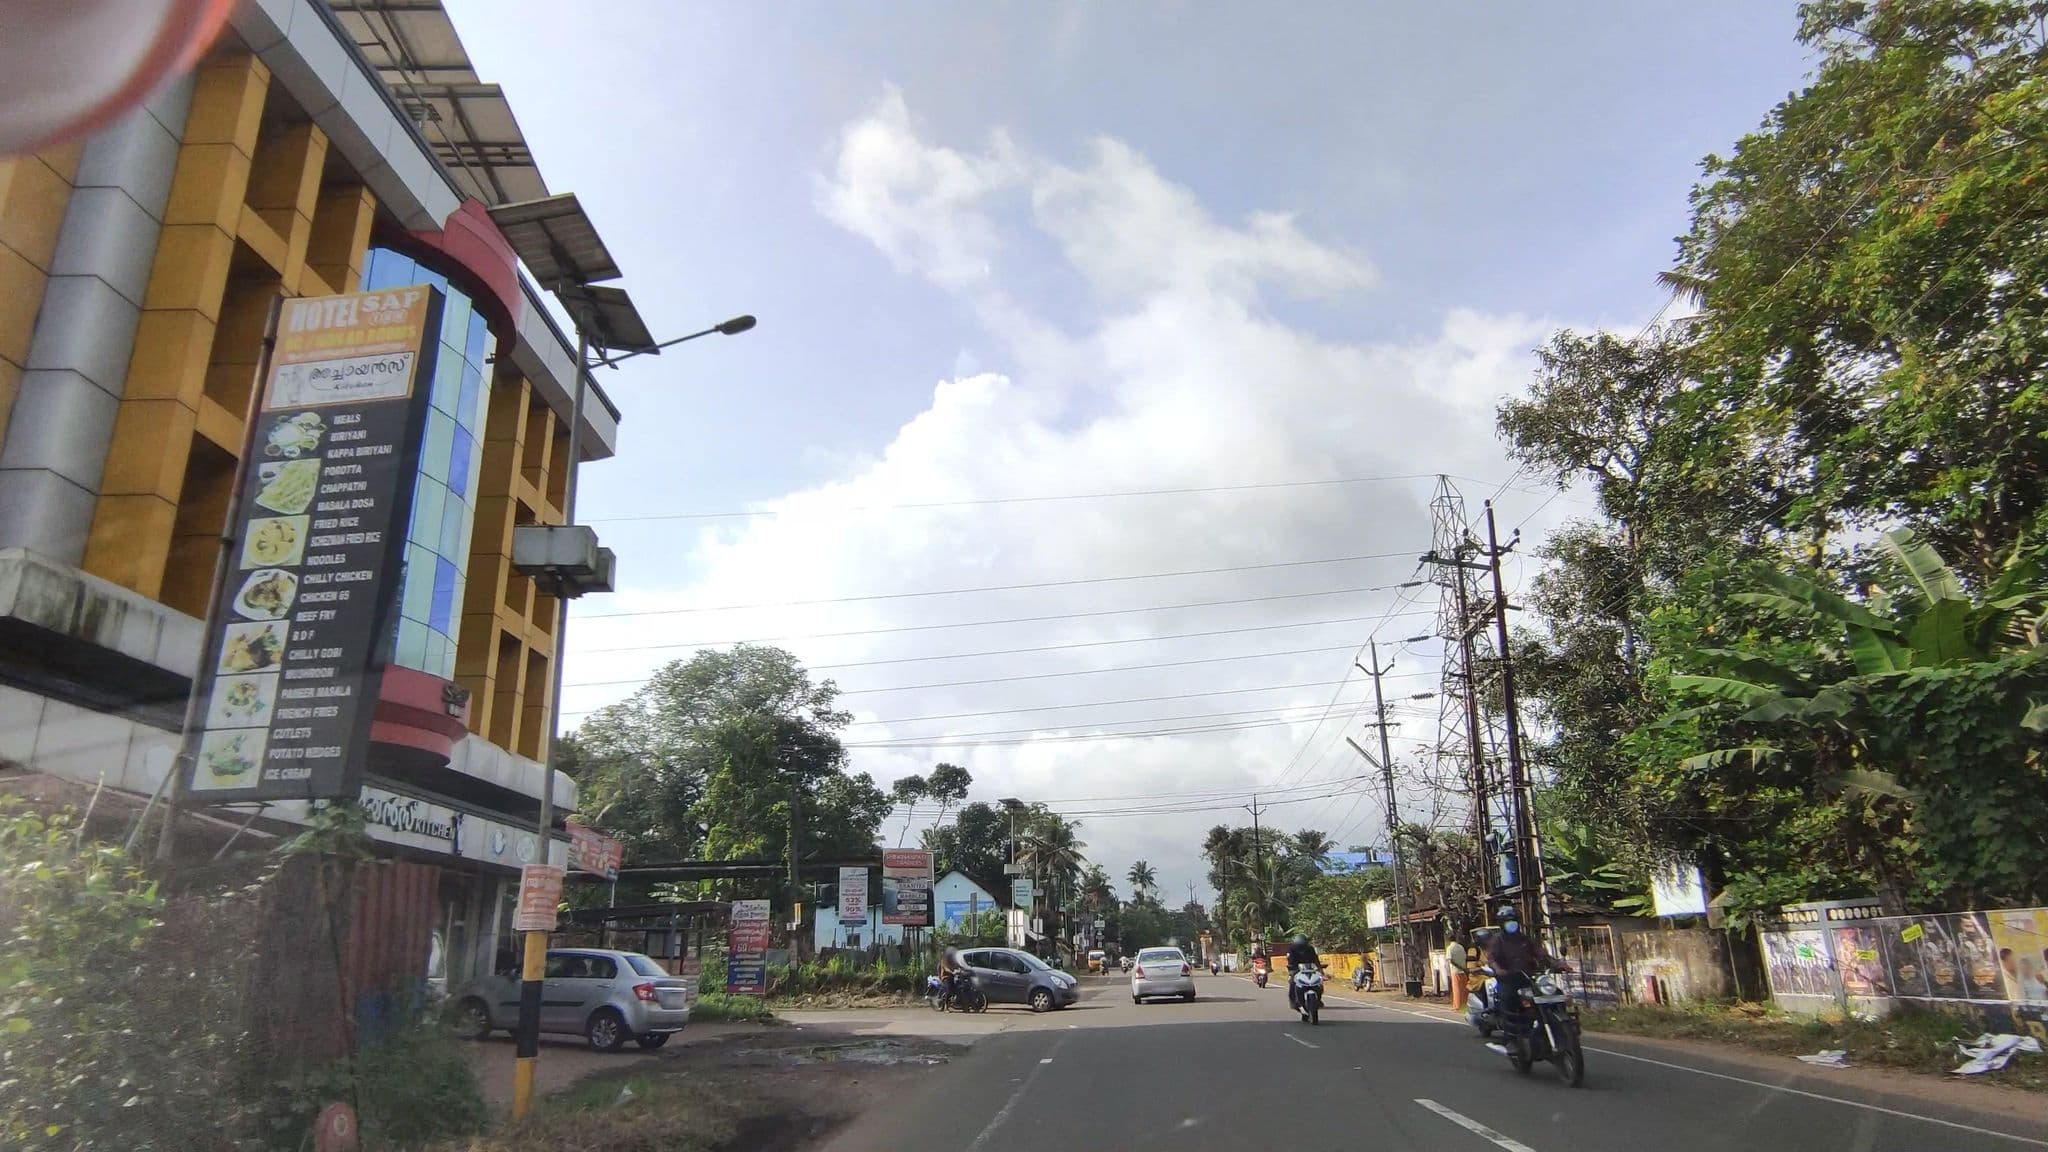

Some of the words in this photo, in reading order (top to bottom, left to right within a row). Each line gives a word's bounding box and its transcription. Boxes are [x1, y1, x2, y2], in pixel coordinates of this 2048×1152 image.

[289, 298, 359, 332] HOTEL
[333, 413, 361, 425] MEALS
[330, 430, 367, 442] BIRIYANI
[327, 448, 354, 459] KAPPA
[355, 445, 393, 457] BIRIYANI
[324, 465, 362, 477] POROTTA
[321, 481, 367, 494] CHAPPATHI
[317, 500, 350, 512] MASALA
[351, 498, 374, 509] DOSA
[314, 518, 338, 529] FRIED
[339, 516, 360, 528] RICE
[365, 531, 381, 543] RICE
[306, 553, 346, 566] NOODLES
[303, 572, 334, 584] CHILLY
[335, 570, 373, 582] CHICKEN
[300, 591, 338, 603] CHICKEN
[296, 611, 319, 622] BEEF
[319, 609, 337, 621] FRY
[288, 648, 320, 660] CHILLY
[320, 647, 343, 659] GOBI
[316, 685, 351, 698] MASALA
[277, 707, 312, 719] FRENCH
[312, 706, 339, 718] FRIES
[272, 726, 312, 740] CUTLETS
[269, 747, 304, 760] POTATO
[264, 768, 280, 780] ICE
[281, 767, 312, 780] CREAM
[414, 818, 456, 840] KITCHEN
